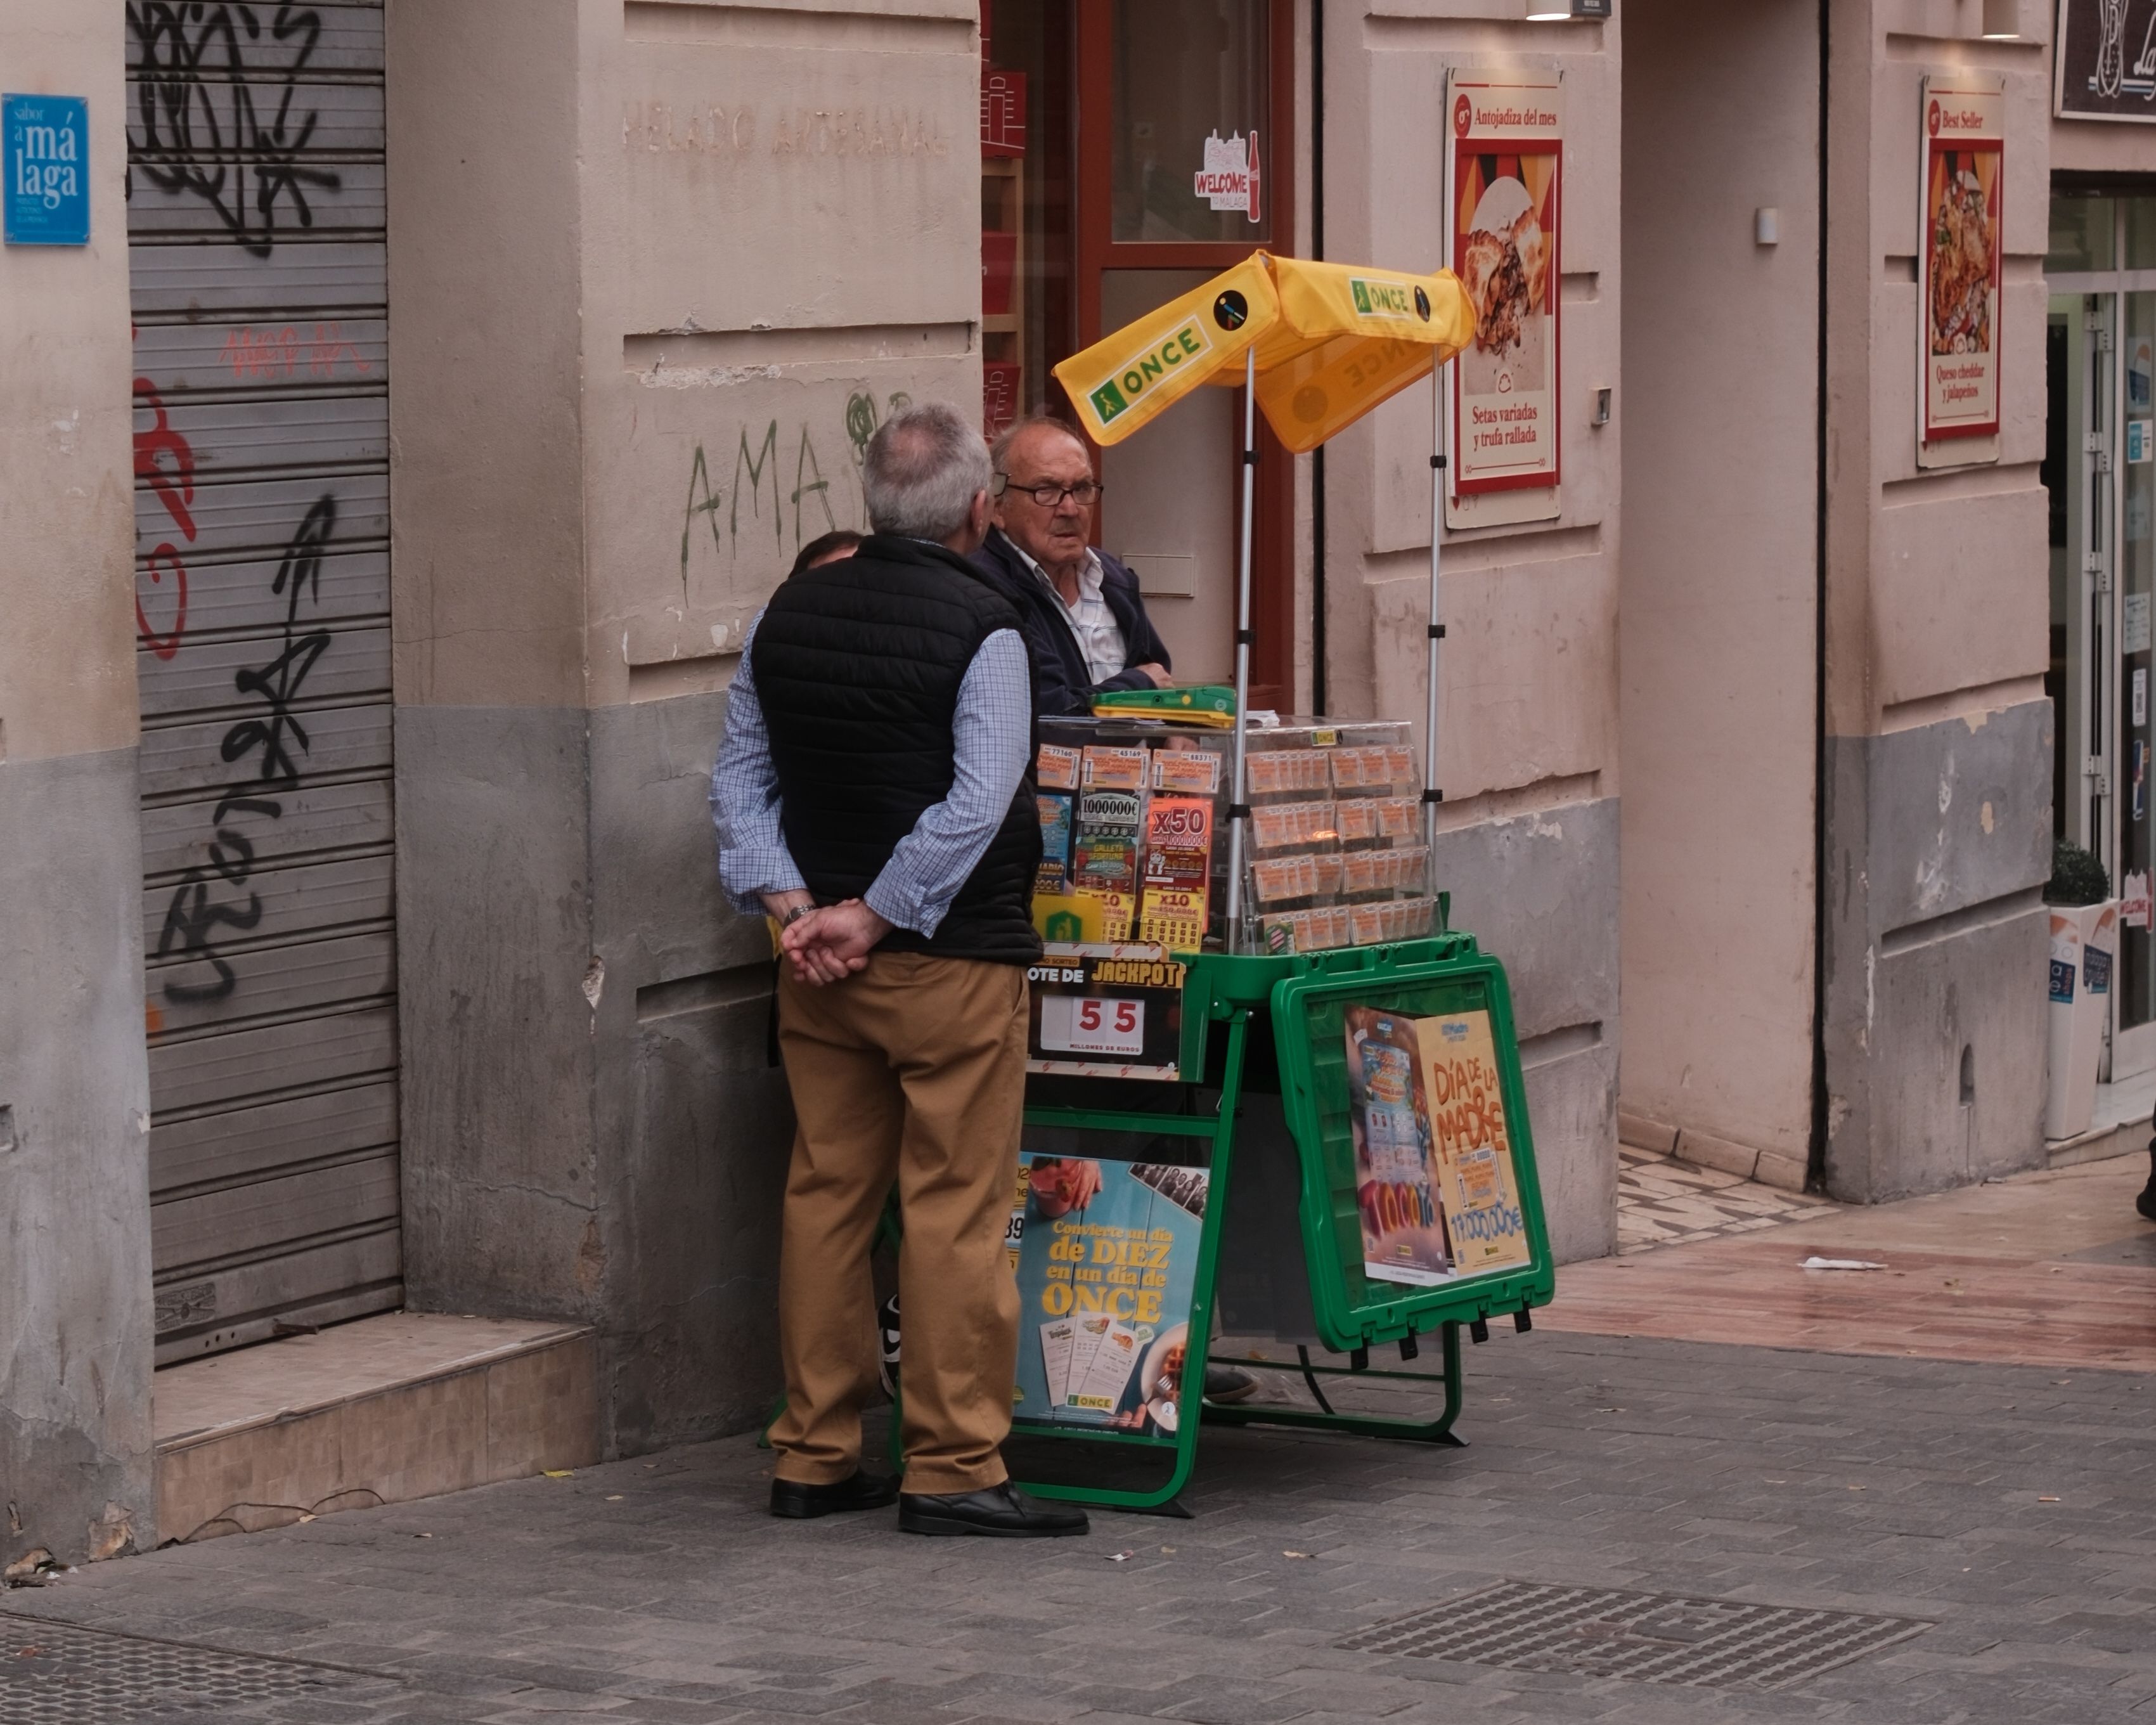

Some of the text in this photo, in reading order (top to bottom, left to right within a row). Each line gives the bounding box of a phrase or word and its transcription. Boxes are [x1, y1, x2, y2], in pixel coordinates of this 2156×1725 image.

[14, 102, 44, 121] sabor
[1475, 107, 1557, 129] Antojadiza del mes
[1942, 110, 1983, 129] Best Seller
[15, 110, 78, 161] a má
[16, 148, 78, 209] laga
[1196, 171, 1248, 194] WELCOME
[1370, 290, 1409, 313] ONCE
[1123, 328, 1201, 394] ONCE
[1937, 363, 1984, 384] Queso cheddar
[1473, 402, 1537, 424] Setas variadas
[1474, 425, 1537, 452] y trufa rallada
[1051, 748, 1073, 758] 77160
[1083, 799, 1138, 816] 1000000€
[1159, 894, 1189, 907] x10
[1027, 960, 1178, 986] OTE DE JACKPOT
[1433, 1057, 1471, 1106] DÍA
[1466, 1057, 1482, 1083] DE
[1483, 1067, 1499, 1092] LA
[1435, 1085, 1507, 1165] MADRE
[1052, 1220, 1173, 1243] Convierte un día
[1049, 1236, 1172, 1269] de DIEZ
[1046, 1265, 1166, 1288] en un día de
[1042, 1282, 1163, 1324] ONCE
[1080, 1397, 1112, 1407] ONCE
